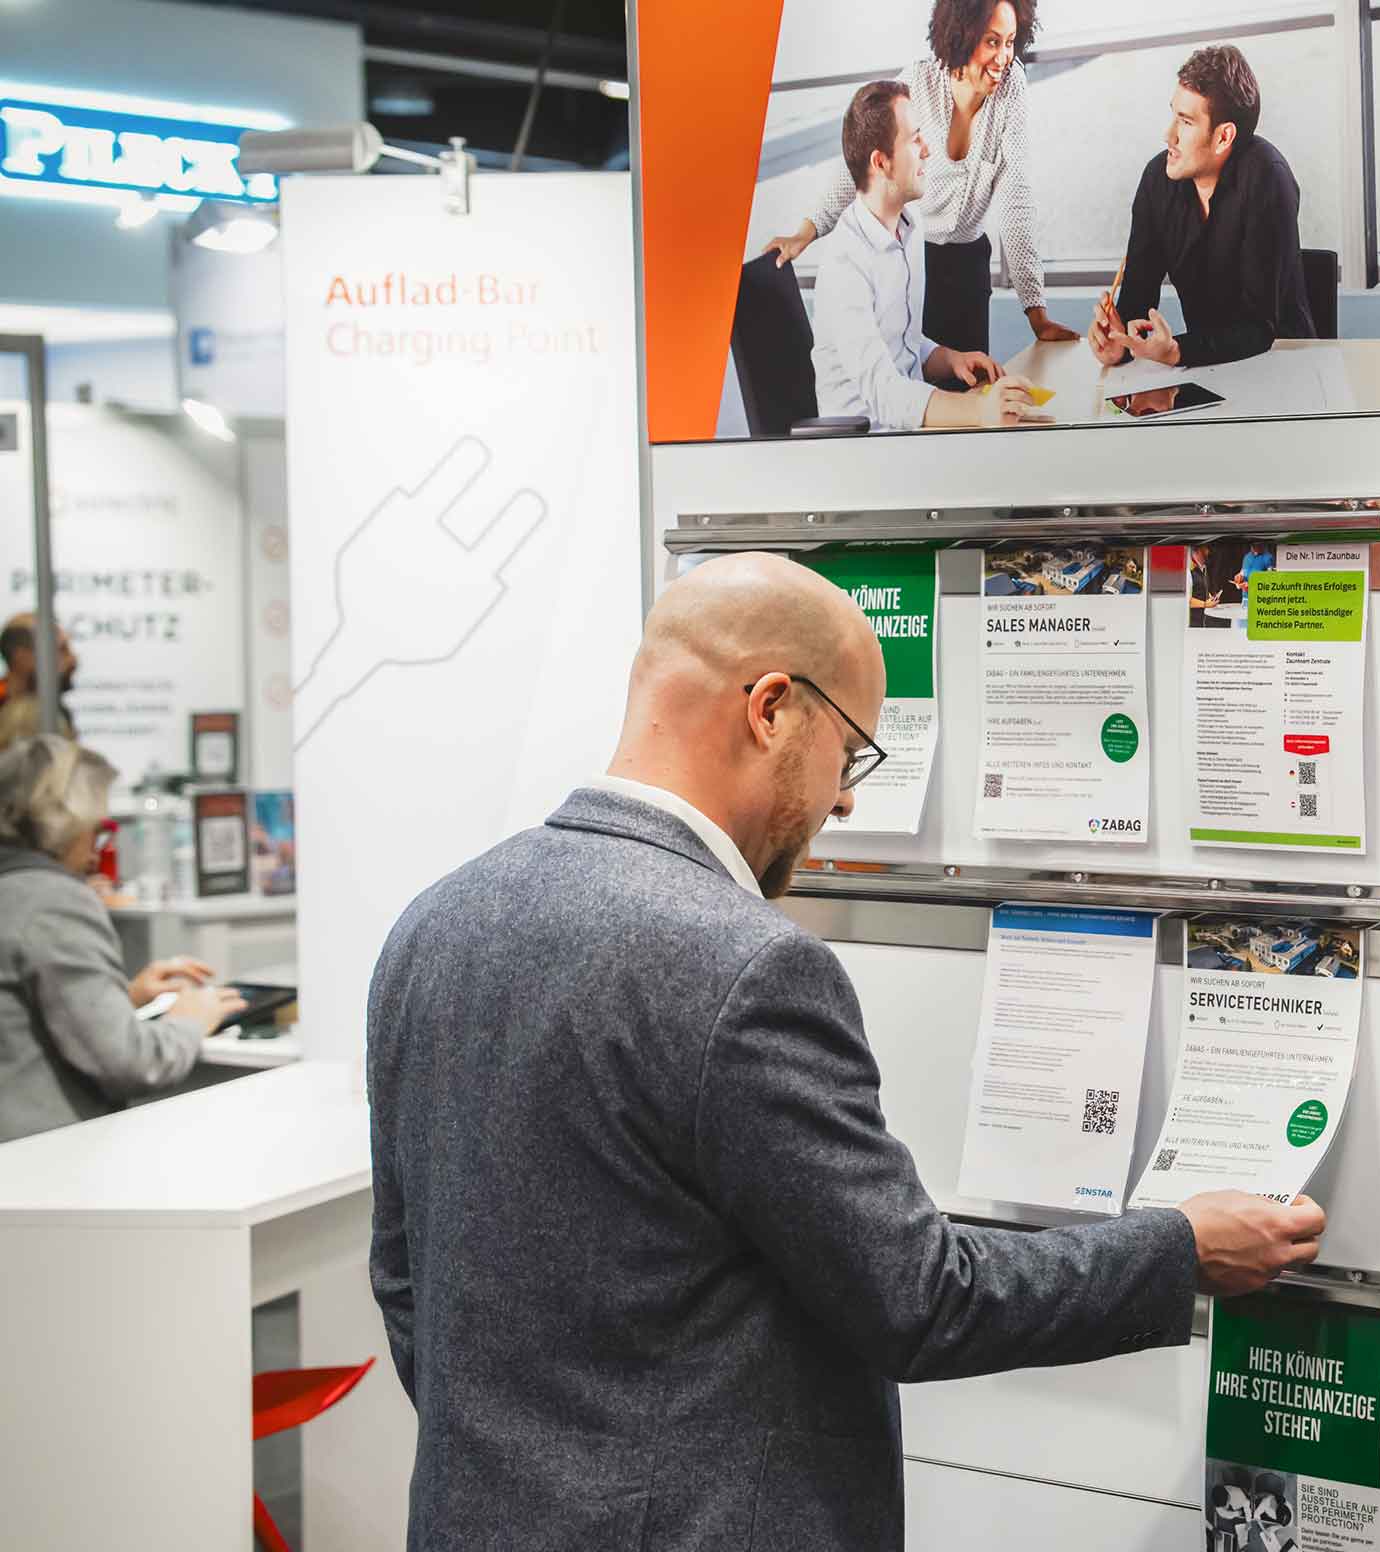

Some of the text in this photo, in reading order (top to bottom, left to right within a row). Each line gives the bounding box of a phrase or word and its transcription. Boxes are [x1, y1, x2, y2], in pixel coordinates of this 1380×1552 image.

[325, 272, 541, 306] Auflad-Bar
[326, 320, 601, 366] Charging Point
[1286, 552, 1298, 560] Die
[1316, 552, 1325, 560] im
[1327, 552, 1360, 560] Zaunbau
[11, 569, 214, 595] PRIMETER-
[1257, 583, 1357, 592] Die Zukunft Ihres Erfolges
[1257, 596, 1307, 605] beginnt jetzt.
[1256, 608, 1353, 618] Werden Sie selbständiger
[68, 612, 180, 642] CHUTZ
[986, 618, 1025, 632] SALES
[1029, 618, 1091, 632] MANAGER
[1256, 620, 1324, 629] Franchise Partner.
[1101, 818, 1141, 832] ZABAG
[1190, 977, 1202, 985] WIR
[1203, 978, 1230, 986] SUCHEN
[1241, 981, 1265, 989] SOFORT
[1189, 992, 1323, 1015] SERVICETECHNIKER
[1075, 1187, 1113, 1198] SENSTAR
[1249, 1346, 1345, 1385] HIER KÖNNTE
[1215, 1371, 1377, 1421] IHRE STELLENANZEIGE
[1264, 1410, 1321, 1442] STEHEN
[1301, 1484, 1339, 1498] SIE SIND
[1301, 1494, 1379, 1515] AUSSTELLER AUF
[1301, 1503, 1375, 1524] DER PERIMETER
[1301, 1513, 1365, 1531] PROTECTION?
